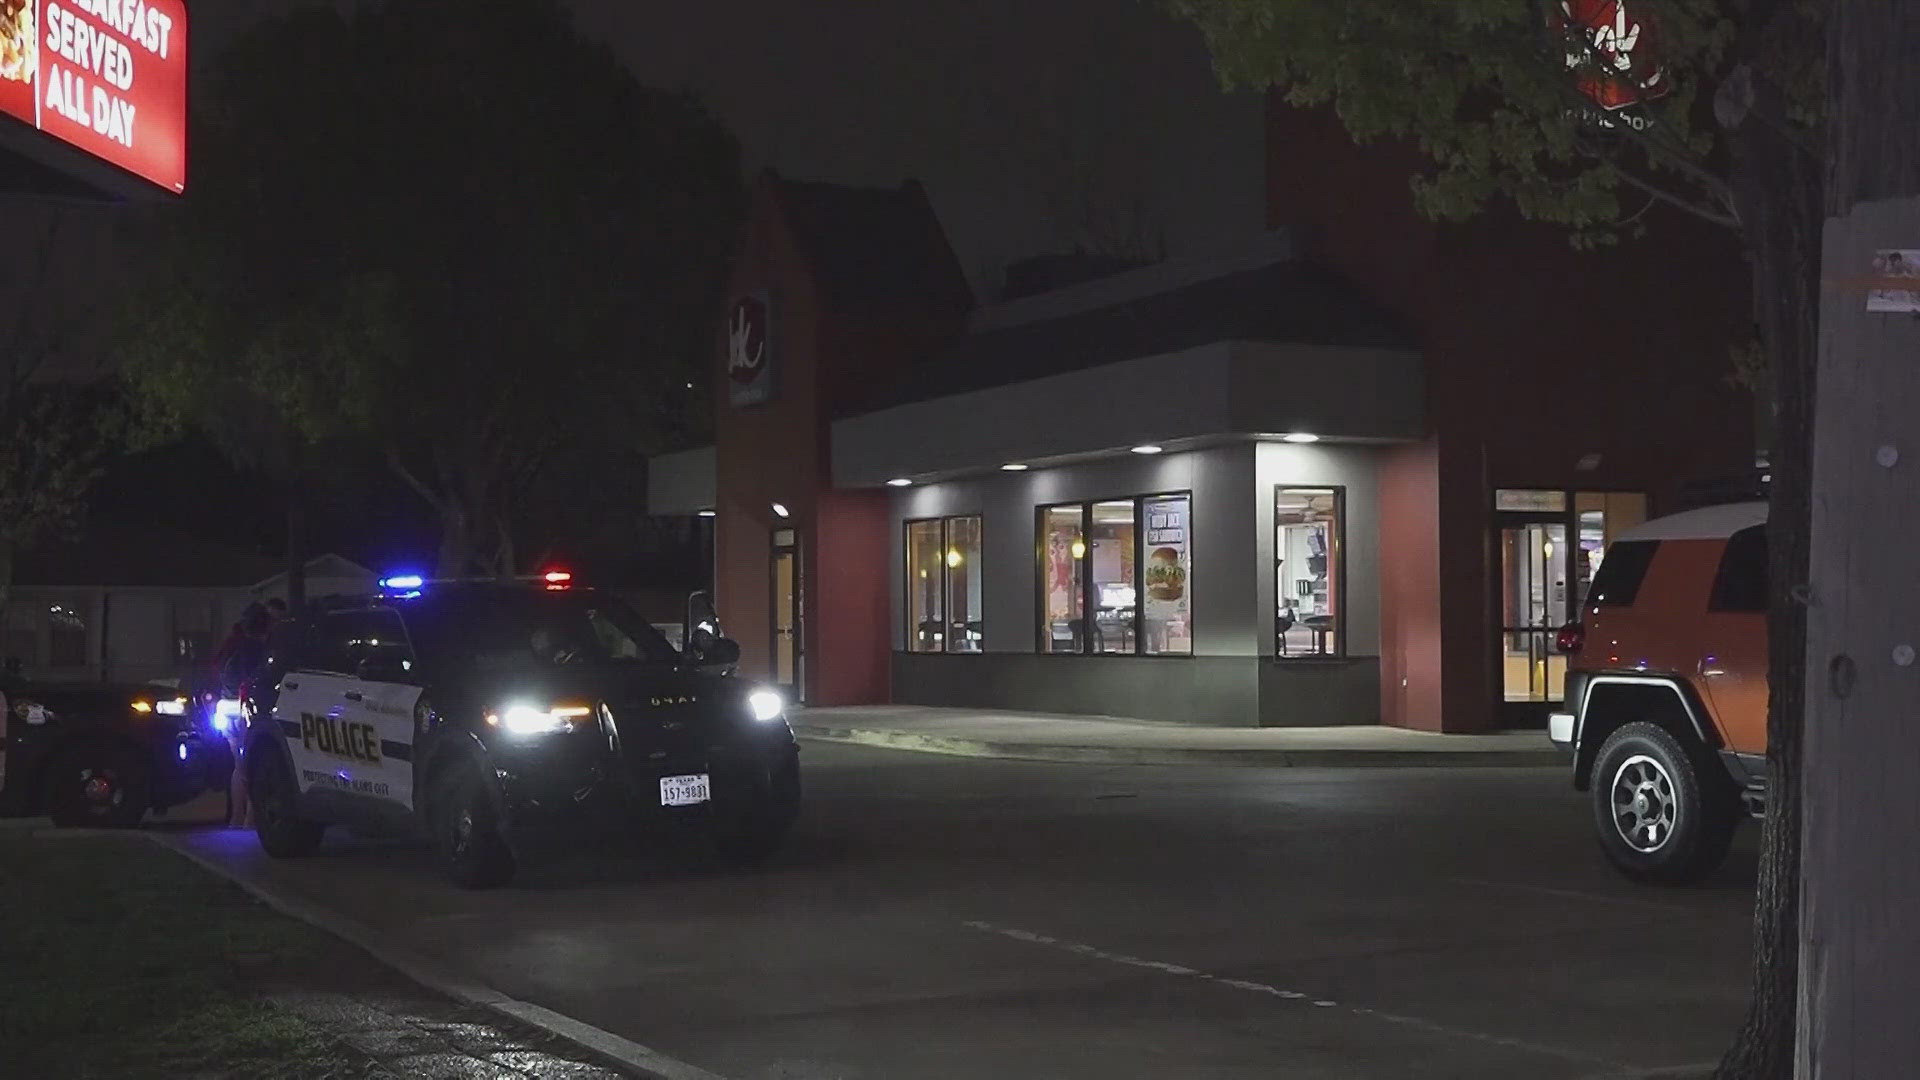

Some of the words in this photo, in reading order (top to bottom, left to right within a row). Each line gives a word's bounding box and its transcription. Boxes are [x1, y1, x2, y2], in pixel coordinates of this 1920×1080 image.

[46, 2, 134, 91] SERVED
[45, 63, 91, 127] ALL
[92, 85, 136, 148] DAY
[301, 712, 381, 763] POLICE
